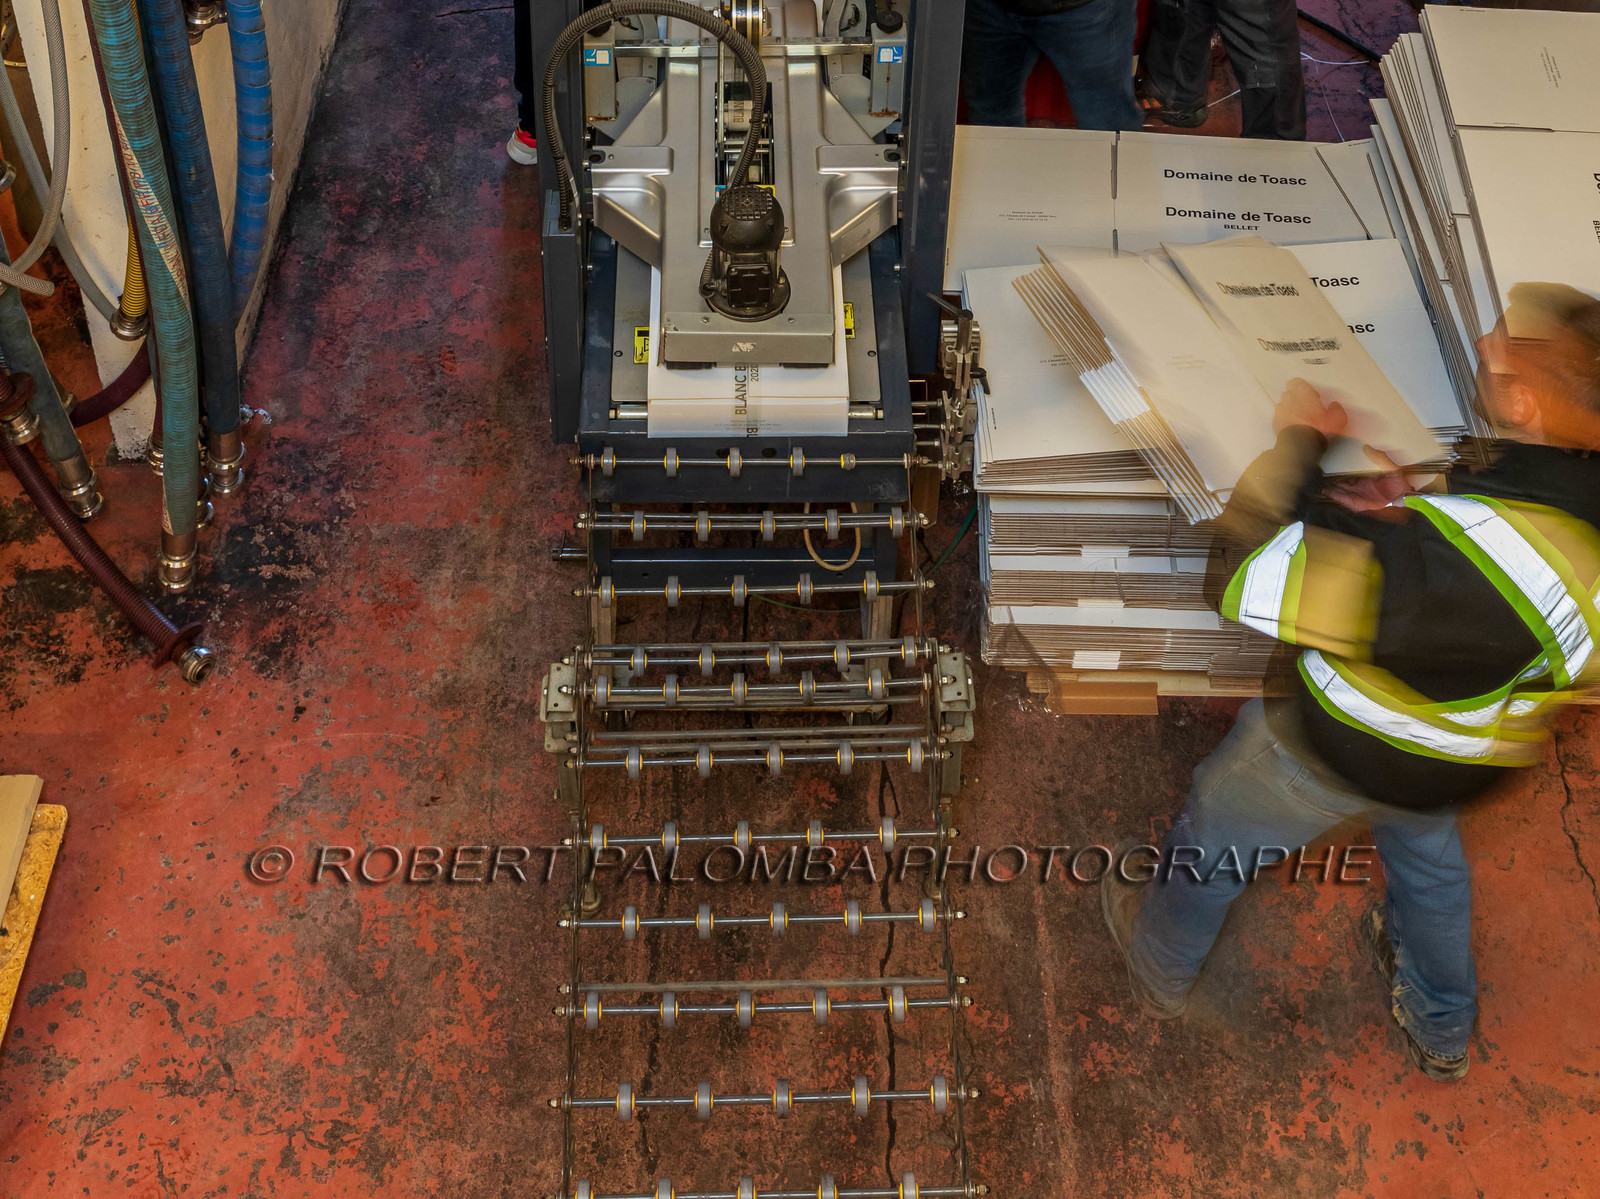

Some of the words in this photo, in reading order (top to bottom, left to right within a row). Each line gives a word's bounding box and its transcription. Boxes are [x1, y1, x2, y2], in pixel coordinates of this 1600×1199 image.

[1164, 169, 1233, 182] Domaine
[1238, 173, 1257, 183] de
[1260, 174, 1307, 186] Toasc
[1165, 206, 1236, 220] Domaine
[1241, 212, 1260, 221] de
[1263, 212, 1311, 224] Toasc
[1309, 276, 1360, 288] Toasc
[735, 375, 747, 415] BLANC
